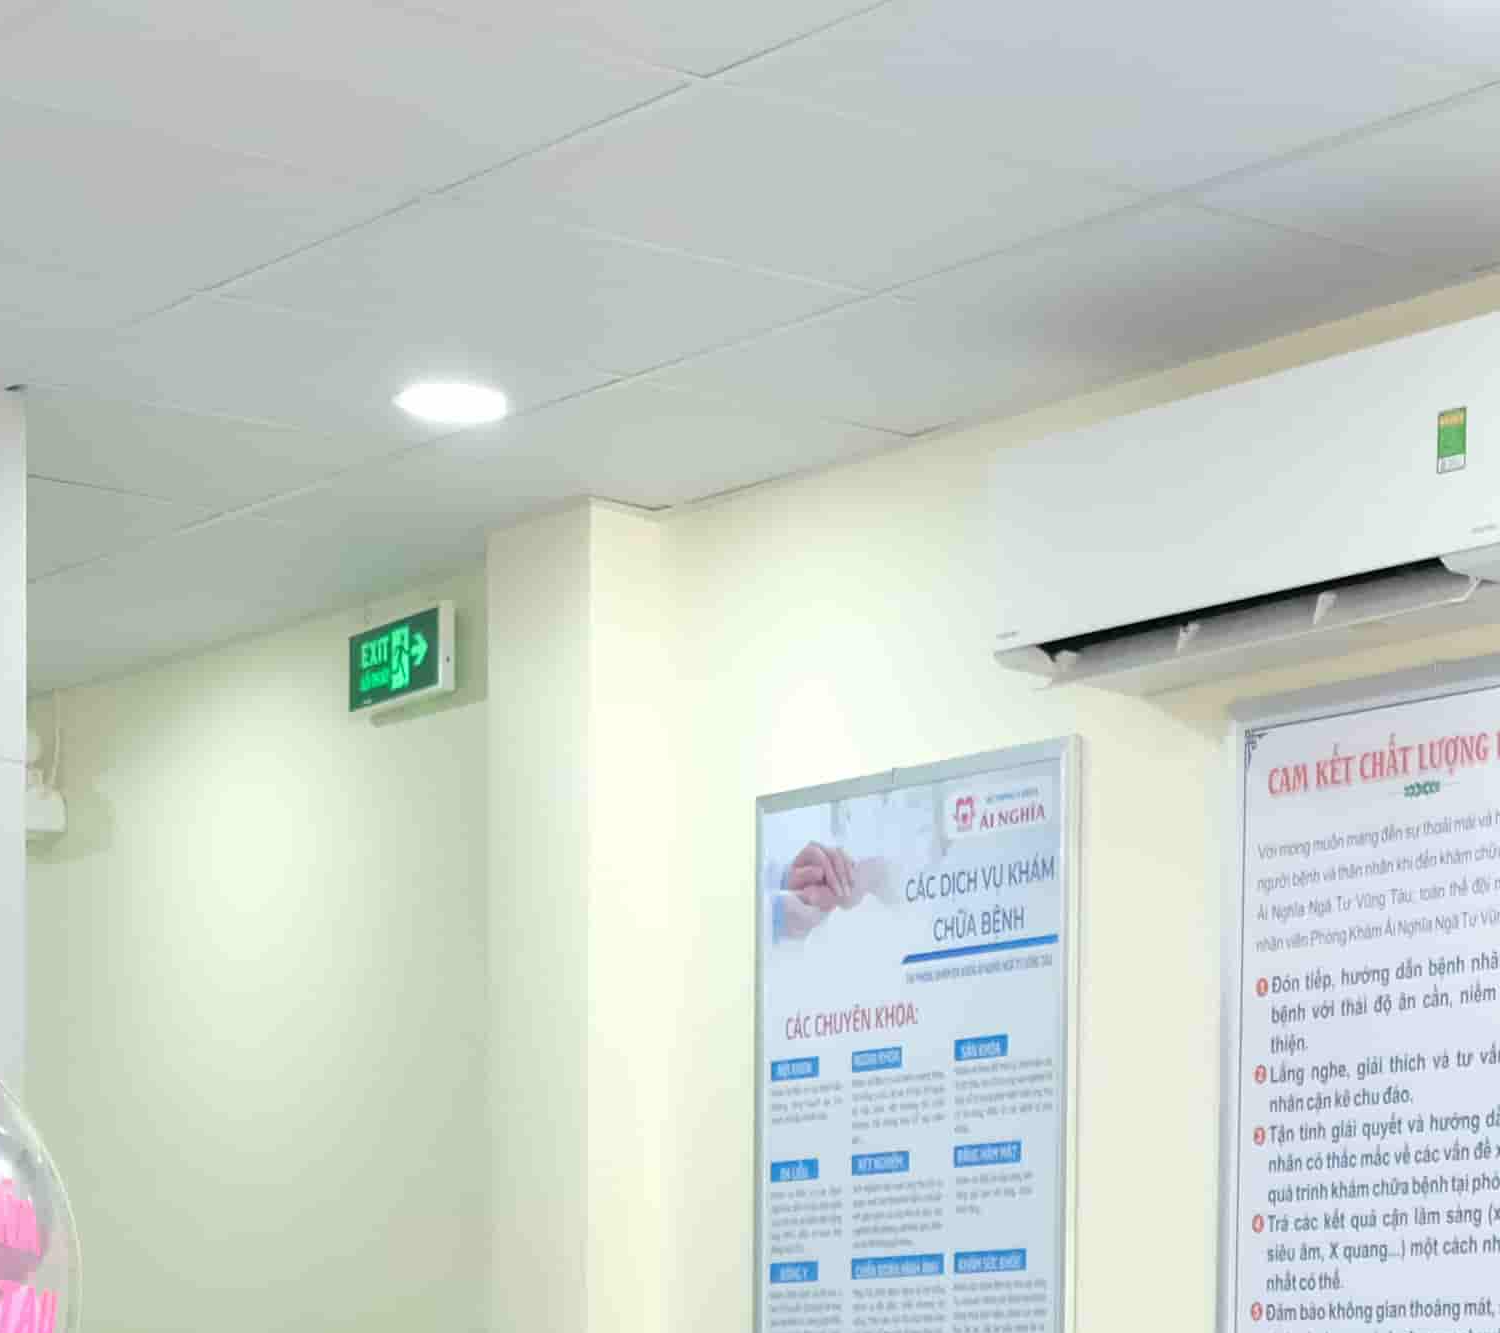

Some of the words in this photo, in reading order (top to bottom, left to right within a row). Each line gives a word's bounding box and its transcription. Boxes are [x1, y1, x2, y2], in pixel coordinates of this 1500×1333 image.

[360, 636, 388, 668] EXIT
[1266, 761, 1309, 797] CAM
[1314, 741, 1357, 790] KẾT
[1357, 731, 1414, 782] CHẤT
[1416, 730, 1489, 772] LƯỢNG
[905, 872, 936, 903] CÁC
[940, 870, 978, 903] DỊCH
[1007, 852, 1056, 888] KHÁM
[932, 907, 978, 942] CHỮA
[786, 1006, 813, 1041] CÁC
[815, 1003, 872, 1037] CHUYÊN
